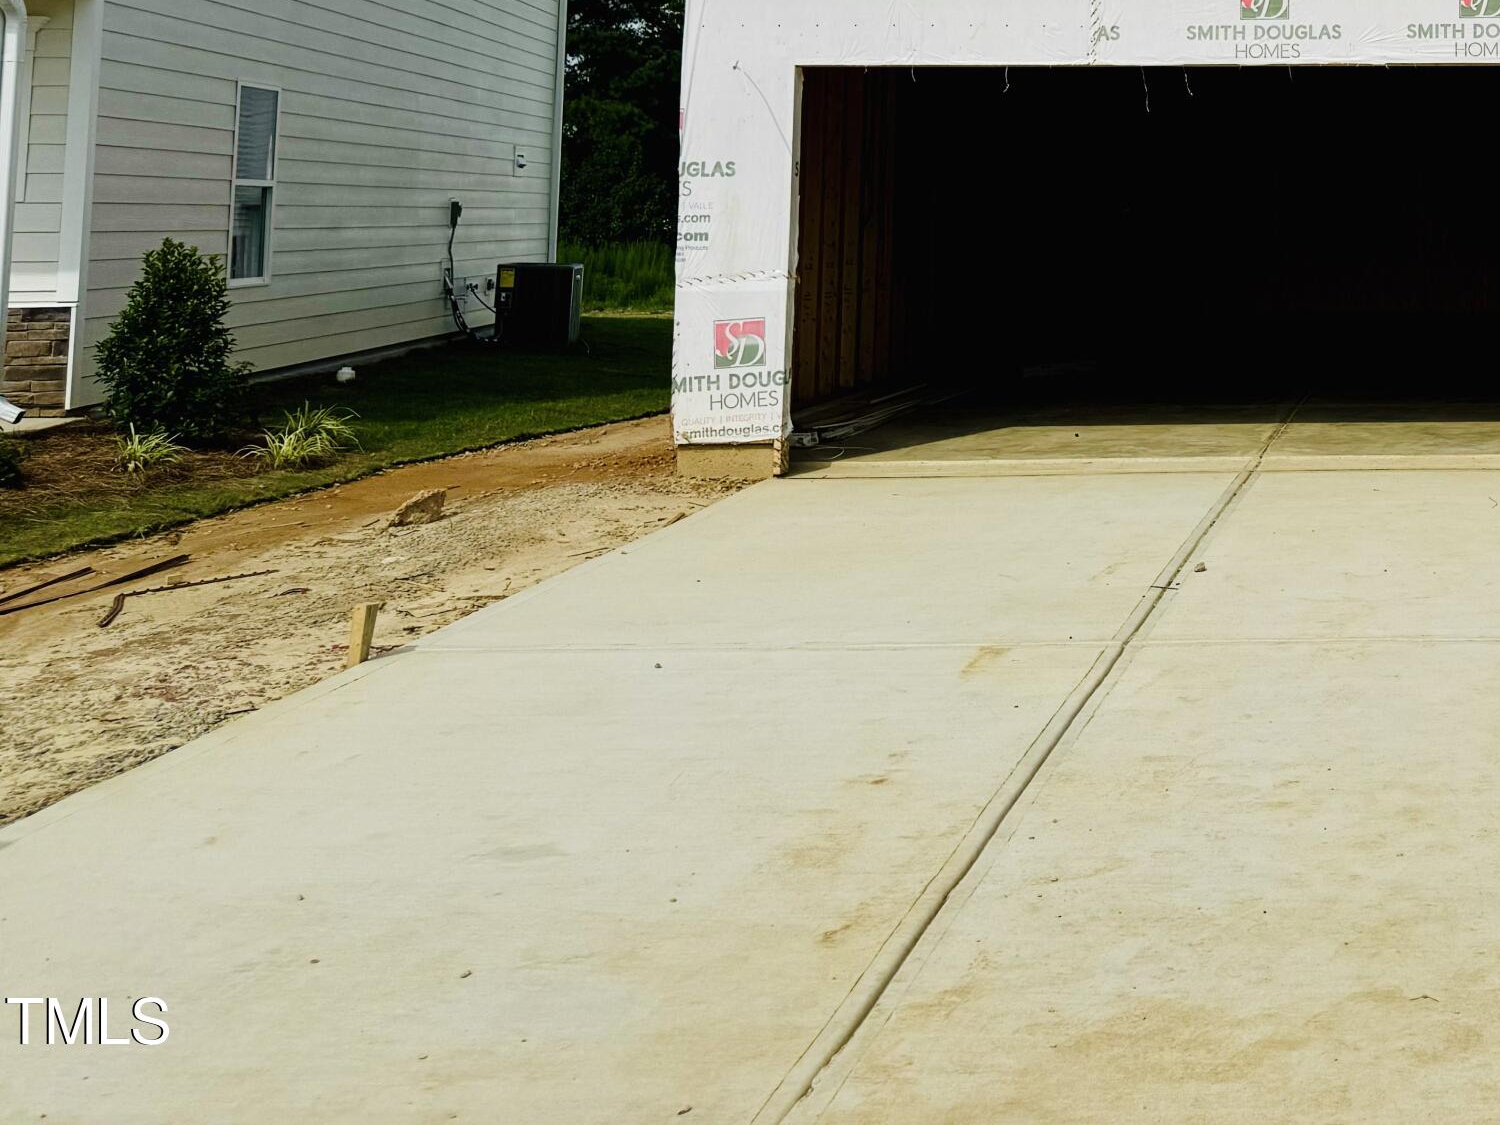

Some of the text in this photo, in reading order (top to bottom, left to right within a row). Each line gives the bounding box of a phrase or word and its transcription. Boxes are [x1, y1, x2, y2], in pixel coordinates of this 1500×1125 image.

[1186, 25, 1342, 40] SMITH DOUGLAS
[1406, 23, 1465, 39] SMITH
[1235, 43, 1301, 59] HOMES
[709, 390, 779, 411] HOMES
